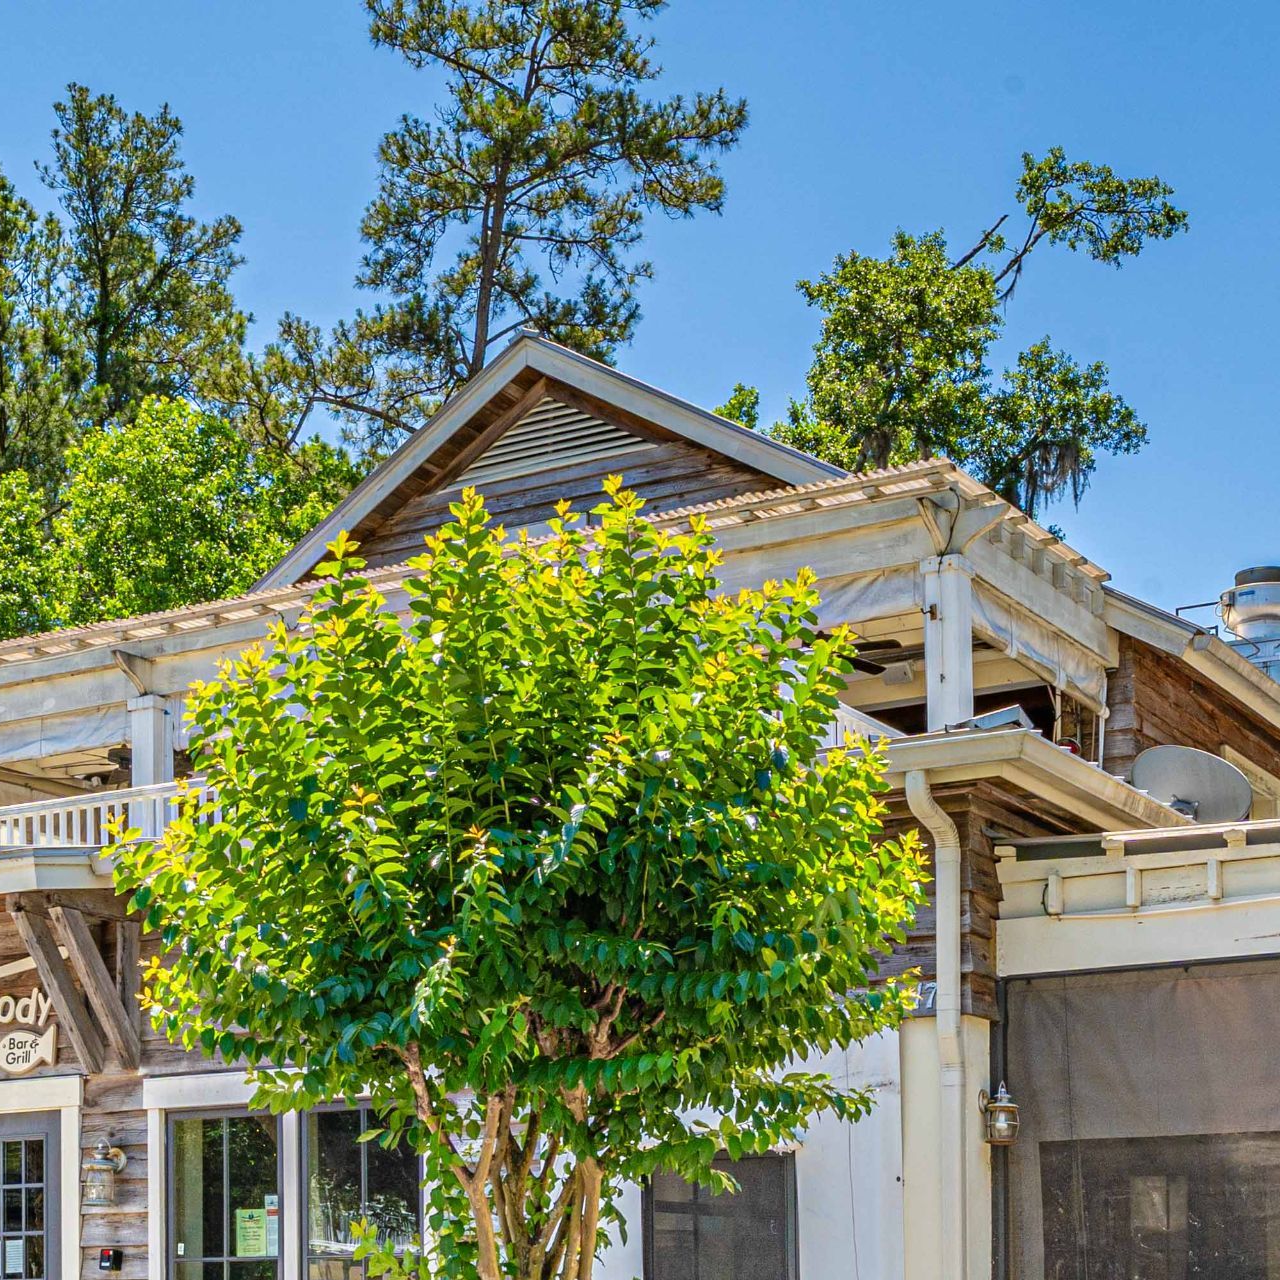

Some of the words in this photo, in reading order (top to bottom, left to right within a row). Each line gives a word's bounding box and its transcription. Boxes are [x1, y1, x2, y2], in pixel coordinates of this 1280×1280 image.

[8, 1038, 28, 1050] Bar
[30, 1038, 40, 1051] &
[6, 1050, 31, 1065] Grill
